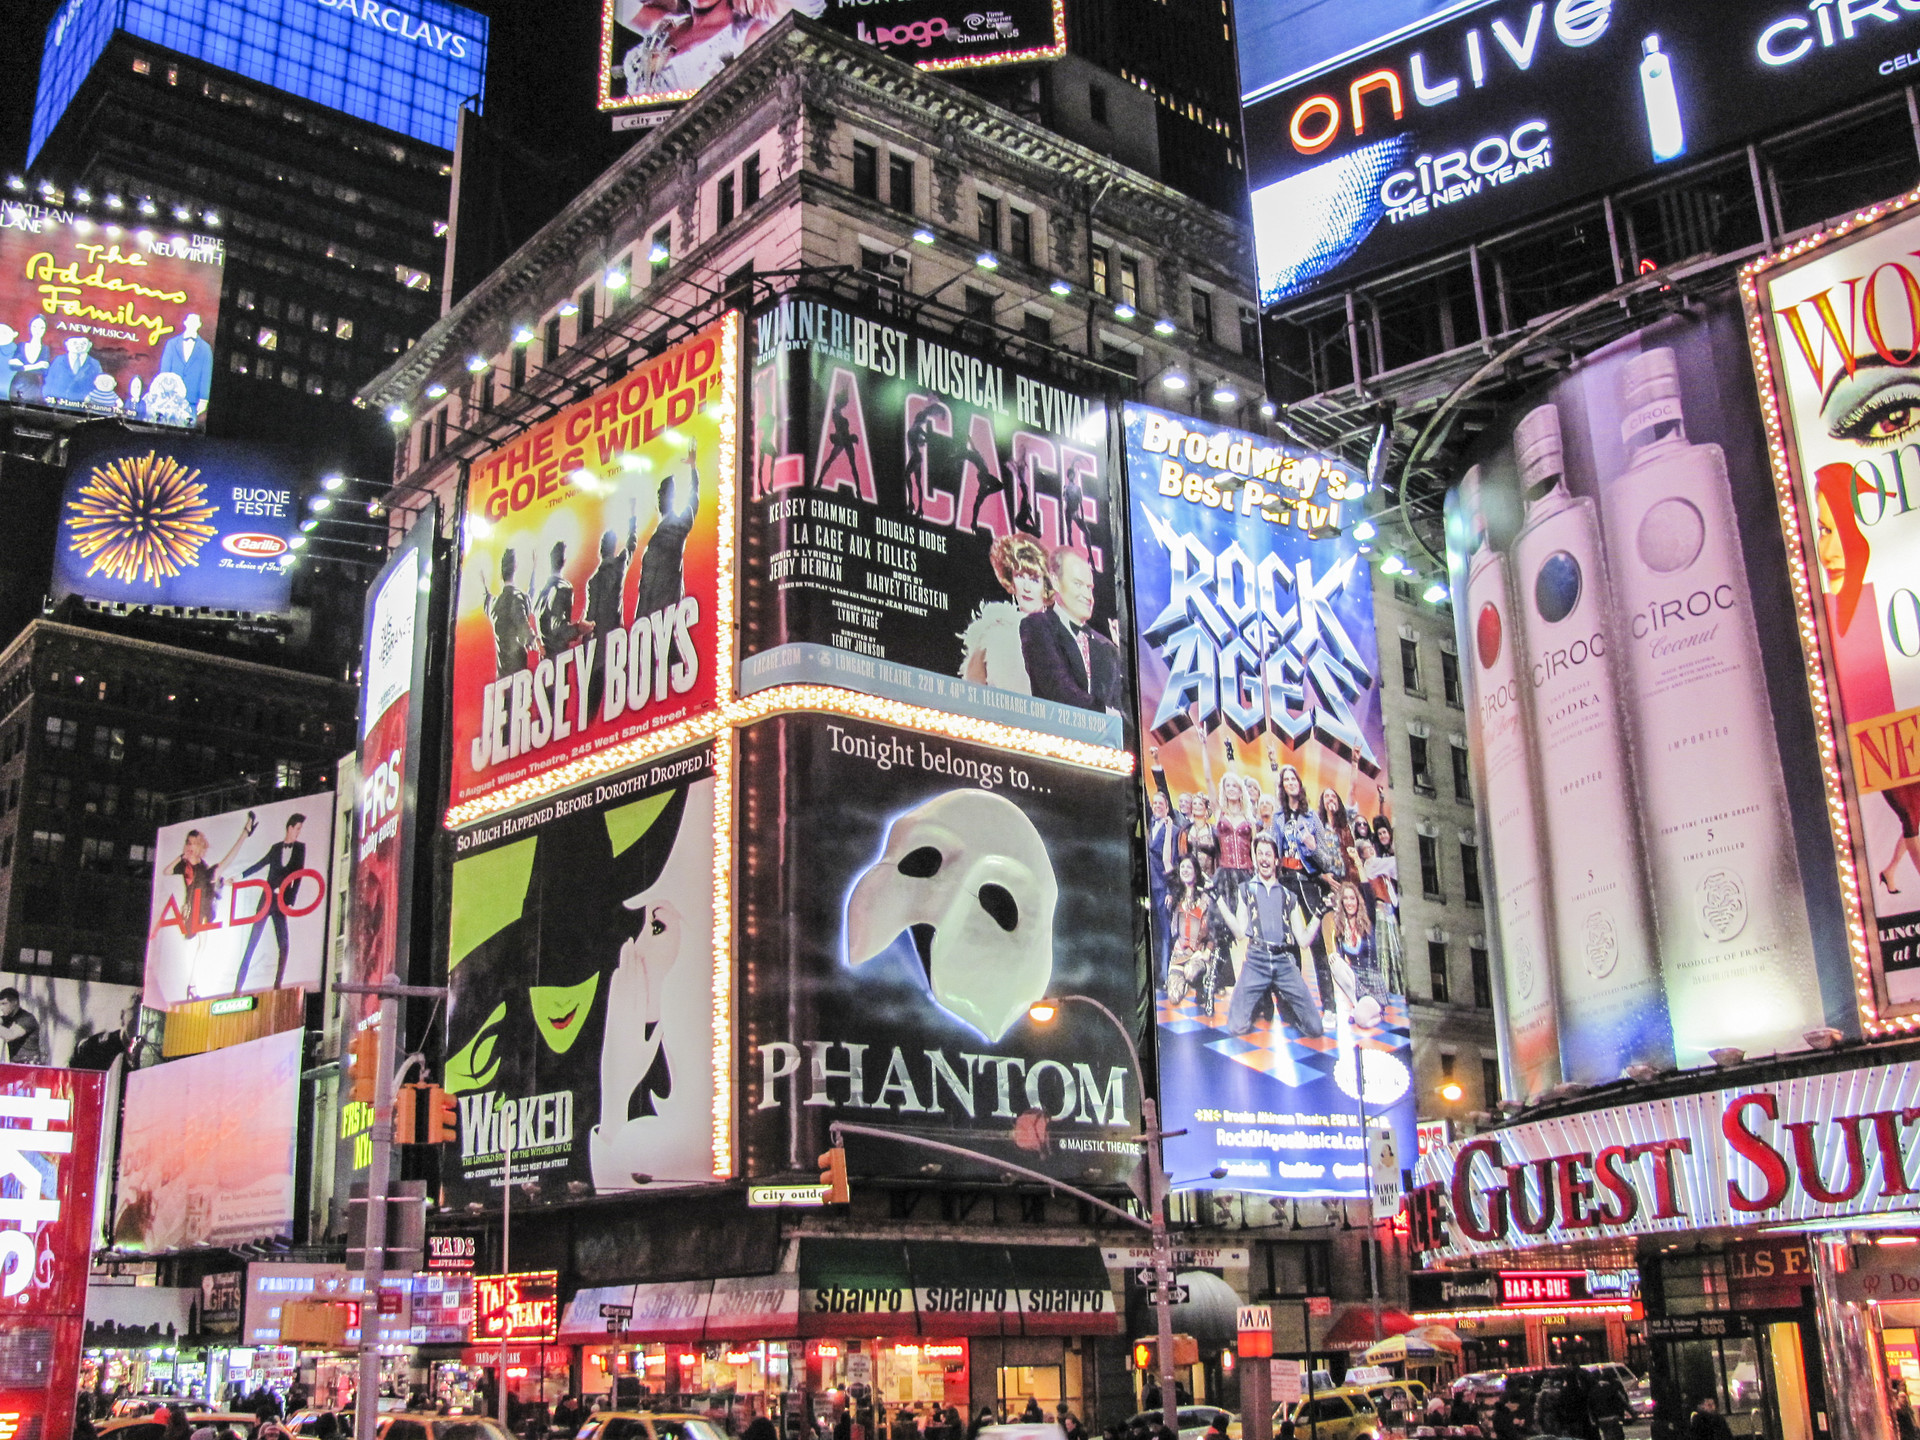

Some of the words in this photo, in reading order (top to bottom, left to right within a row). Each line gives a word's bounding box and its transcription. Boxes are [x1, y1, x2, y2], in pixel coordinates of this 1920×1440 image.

[957, 31, 999, 43] Channel
[631, 116, 650, 125] city
[1386, 199, 1429, 223] THE
[1432, 179, 1481, 213] NEW
[1485, 151, 1552, 192] YEAR!
[0, 214, 42, 233] LANE
[1, 200, 74, 225] NATHAN
[75, 243, 148, 266] The
[149, 241, 223, 266] NEUWIRTH
[192, 234, 225, 251] BEBE
[26, 252, 188, 304] Addams
[38, 284, 174, 346] Family
[56, 321, 68, 331] A
[69, 322, 92, 333] NEW
[92, 326, 140, 342] MUSICAL
[756, 348, 776, 366] 2010
[813, 343, 851, 361] AWARD
[757, 301, 851, 354] WINNER!
[854, 316, 908, 380] BEST
[917, 337, 1009, 416] MUSICAL
[1016, 374, 1097, 447] REVIVAL
[564, 338, 716, 447] CROWD
[1142, 413, 1348, 501] Broadway's
[233, 487, 290, 504] BUONE
[484, 447, 586, 525] GOES
[905, 393, 1103, 574] CAGE
[1159, 459, 1234, 513] Best
[235, 501, 287, 518] FESTE.
[769, 498, 806, 524] KELSEY
[811, 500, 859, 528] GRAMMER
[876, 517, 915, 545] DOUGLAS
[919, 532, 947, 554] HODGE
[238, 538, 281, 552] Barilla
[770, 550, 791, 564] MUSIC
[801, 549, 831, 561] LYRICS
[833, 555, 843, 564] BY
[793, 523, 809, 545] LA
[815, 525, 844, 552] CAGE
[849, 535, 871, 559] AUX
[877, 542, 917, 572] FOLLES
[219, 558, 235, 569] The
[235, 560, 256, 570] choice
[257, 562, 266, 574] of
[267, 562, 287, 575] Italy
[769, 558, 795, 582] JERRY
[801, 557, 842, 582] HERMAN
[893, 571, 911, 583] BOOK
[914, 577, 923, 586] BY
[866, 572, 901, 597] HARVEY
[904, 582, 949, 610] FIERSTEIN
[1140, 501, 1373, 691] ROCK
[838, 607, 860, 626] LYNNE
[862, 613, 879, 630] PAGE
[885, 599, 902, 610] JEAN
[904, 604, 928, 617] POIRET
[832, 634, 852, 651] TERRY
[854, 637, 885, 659] JOHNSON
[1243, 618, 1282, 655] OF
[1649, 623, 1718, 659] Coconut
[471, 639, 597, 773] JERSEY
[603, 596, 700, 722] BOYS
[835, 653, 875, 679] LONGACRE
[918, 673, 934, 693] 220
[936, 678, 947, 697] W.
[967, 685, 979, 703] ST.
[982, 689, 1046, 720] TELECHARGE.COM
[1150, 622, 1382, 780] AGES
[1546, 694, 1600, 725] VODKA
[465, 781, 496, 798] August
[497, 767, 527, 787] Wilson
[571, 743, 592, 759] 245
[594, 733, 620, 749] West
[622, 721, 650, 738] 52nd
[652, 706, 687, 728] Street
[827, 724, 915, 771] Tonight
[921, 742, 1004, 790] belongs
[361, 749, 401, 839] FRS
[502, 807, 553, 836] HAPPENED
[555, 793, 593, 819] BEFORE
[595, 773, 649, 805] DOROTHY
[651, 757, 701, 786] DROPPED
[1707, 828, 1714, 842] 5
[1587, 869, 1594, 883] 5
[150, 868, 326, 940] ALDO
[1676, 955, 1720, 970] PRODUCT
[1723, 953, 1737, 962] OF
[757, 1041, 1130, 1128] PHANTOM
[1067, 1137, 1104, 1153] MAJESTIC
[1106, 1140, 1140, 1155] THEATRE
[763, 1187, 785, 1201] city
[1374, 1182, 1398, 1194] MAMMA
[1450, 1137, 1692, 1242] GUEST
[430, 1236, 475, 1257] TADS
[1129, 1249, 1155, 1257] SPAC
[1194, 1249, 1220, 1257] RENT
[1731, 1250, 1774, 1279] LLS
[719, 1288, 785, 1316] sbarro
[815, 1283, 903, 1313] sbarro
[926, 1284, 1006, 1312] sbarro
[1028, 1284, 1103, 1312] sbarro
[1504, 1278, 1569, 1299] BAR-B-QUE
[641, 1293, 698, 1320] sbarro
[1239, 1309, 1254, 1328] M
[1257, 1308, 1271, 1327] M
[1542, 1316, 1566, 1324] CHICKEN
[1458, 1319, 1477, 1329] RIBS
